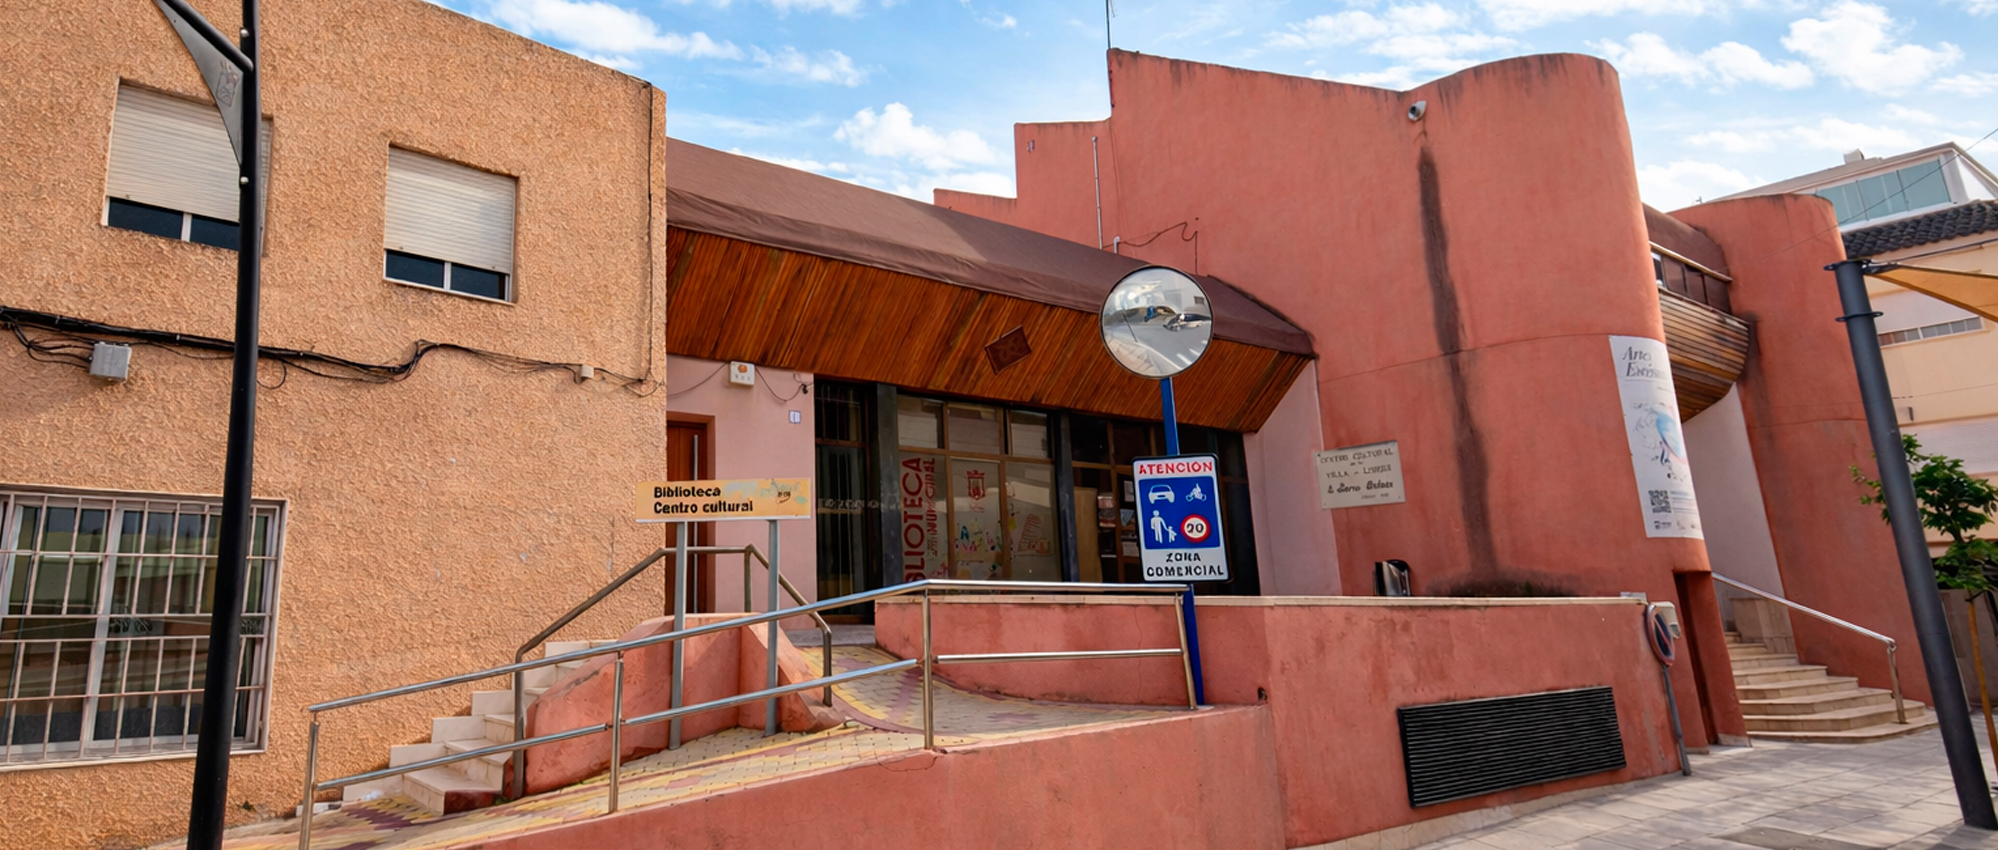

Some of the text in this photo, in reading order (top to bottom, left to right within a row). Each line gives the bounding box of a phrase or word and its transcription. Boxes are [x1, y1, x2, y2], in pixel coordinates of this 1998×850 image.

[654, 486, 721, 498] Biblioteca
[654, 501, 754, 514] Centro cultural
[1166, 552, 1201, 563] ZONA
[1146, 565, 1225, 577] COMERCIAL
